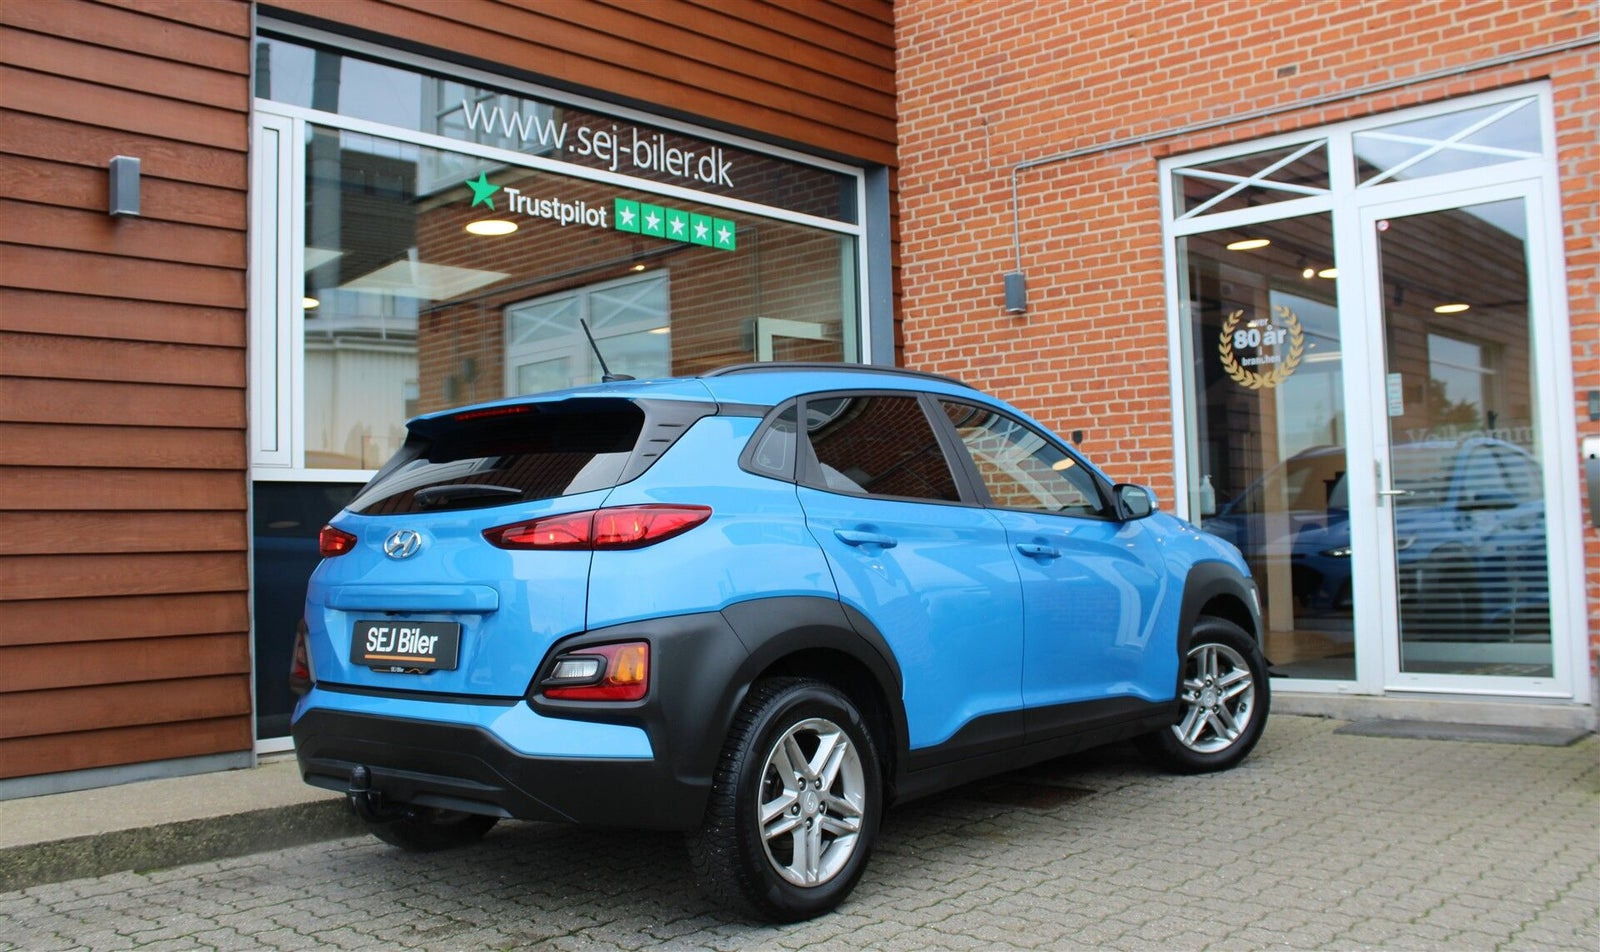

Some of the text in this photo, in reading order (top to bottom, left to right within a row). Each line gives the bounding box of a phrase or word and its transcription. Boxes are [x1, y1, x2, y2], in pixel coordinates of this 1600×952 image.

[462, 99, 734, 188] www.sej-biler.dk
[503, 187, 608, 228] Trustpilot
[1234, 324, 1286, 348] 80 år
[366, 626, 438, 654] SEJ Biler
